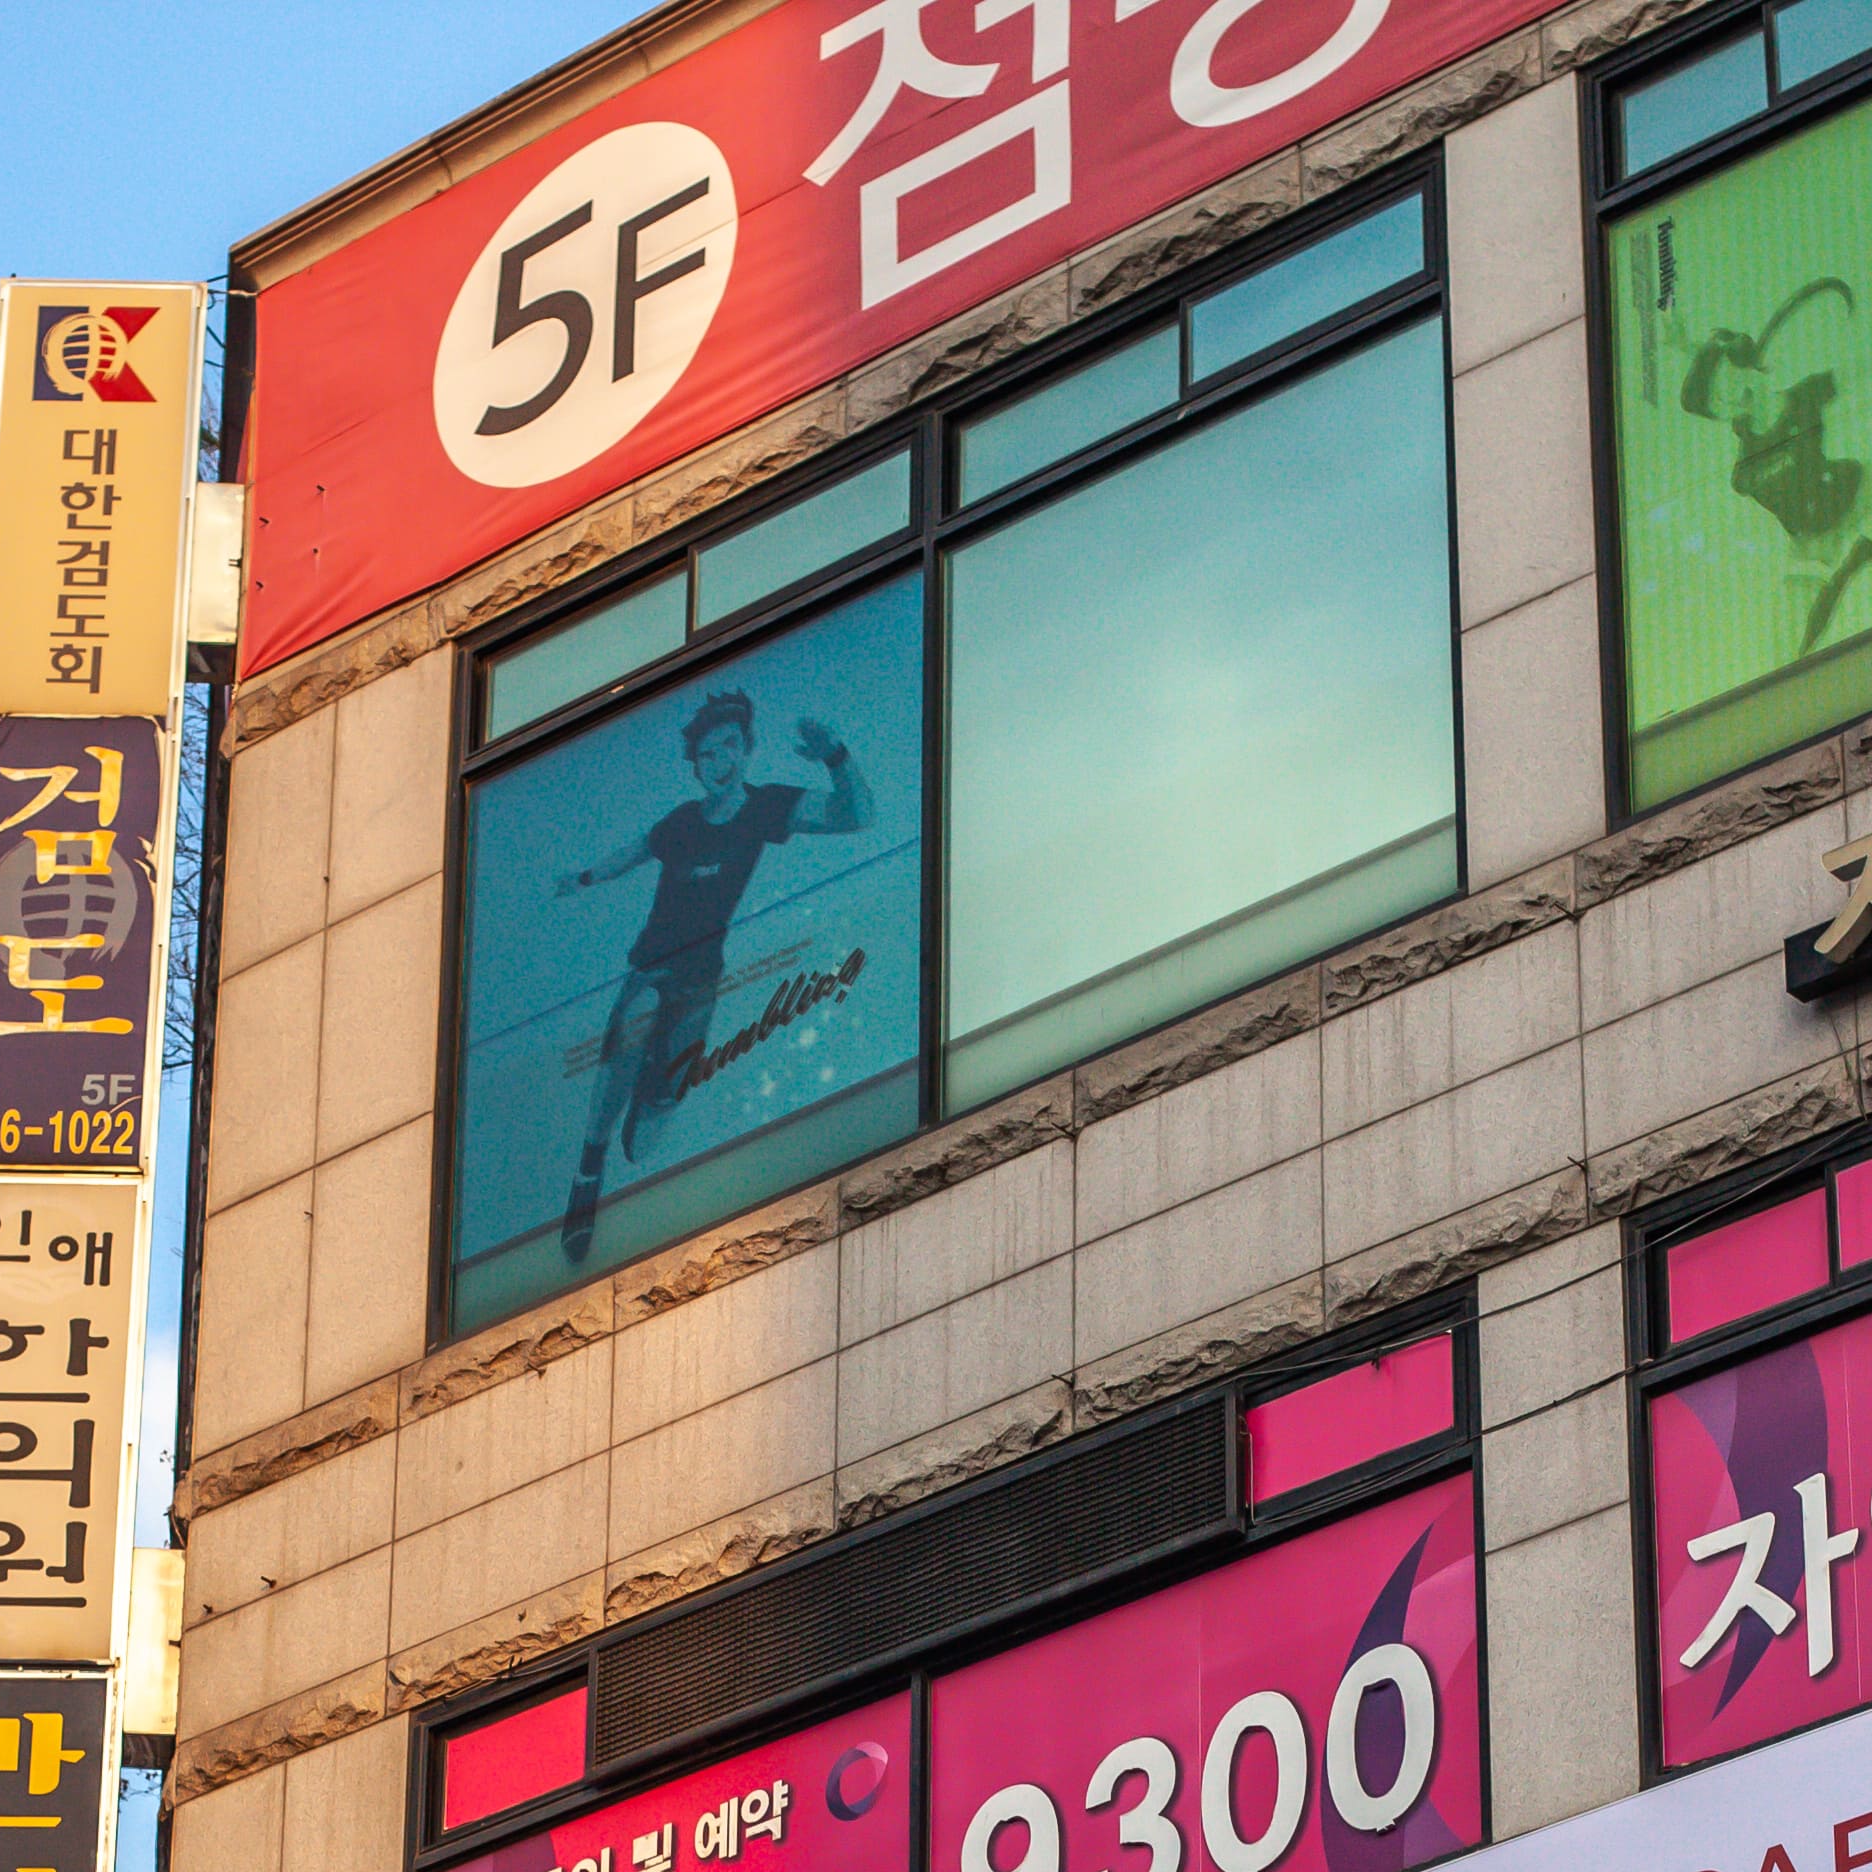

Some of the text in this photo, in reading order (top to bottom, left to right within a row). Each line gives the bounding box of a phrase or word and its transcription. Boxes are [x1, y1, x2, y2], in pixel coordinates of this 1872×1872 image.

[474, 175, 713, 437] 5F
[45, 427, 122, 696] 대한검도회
[80, 1074, 137, 1108] 5F
[693, 1780, 792, 1866] 예약
